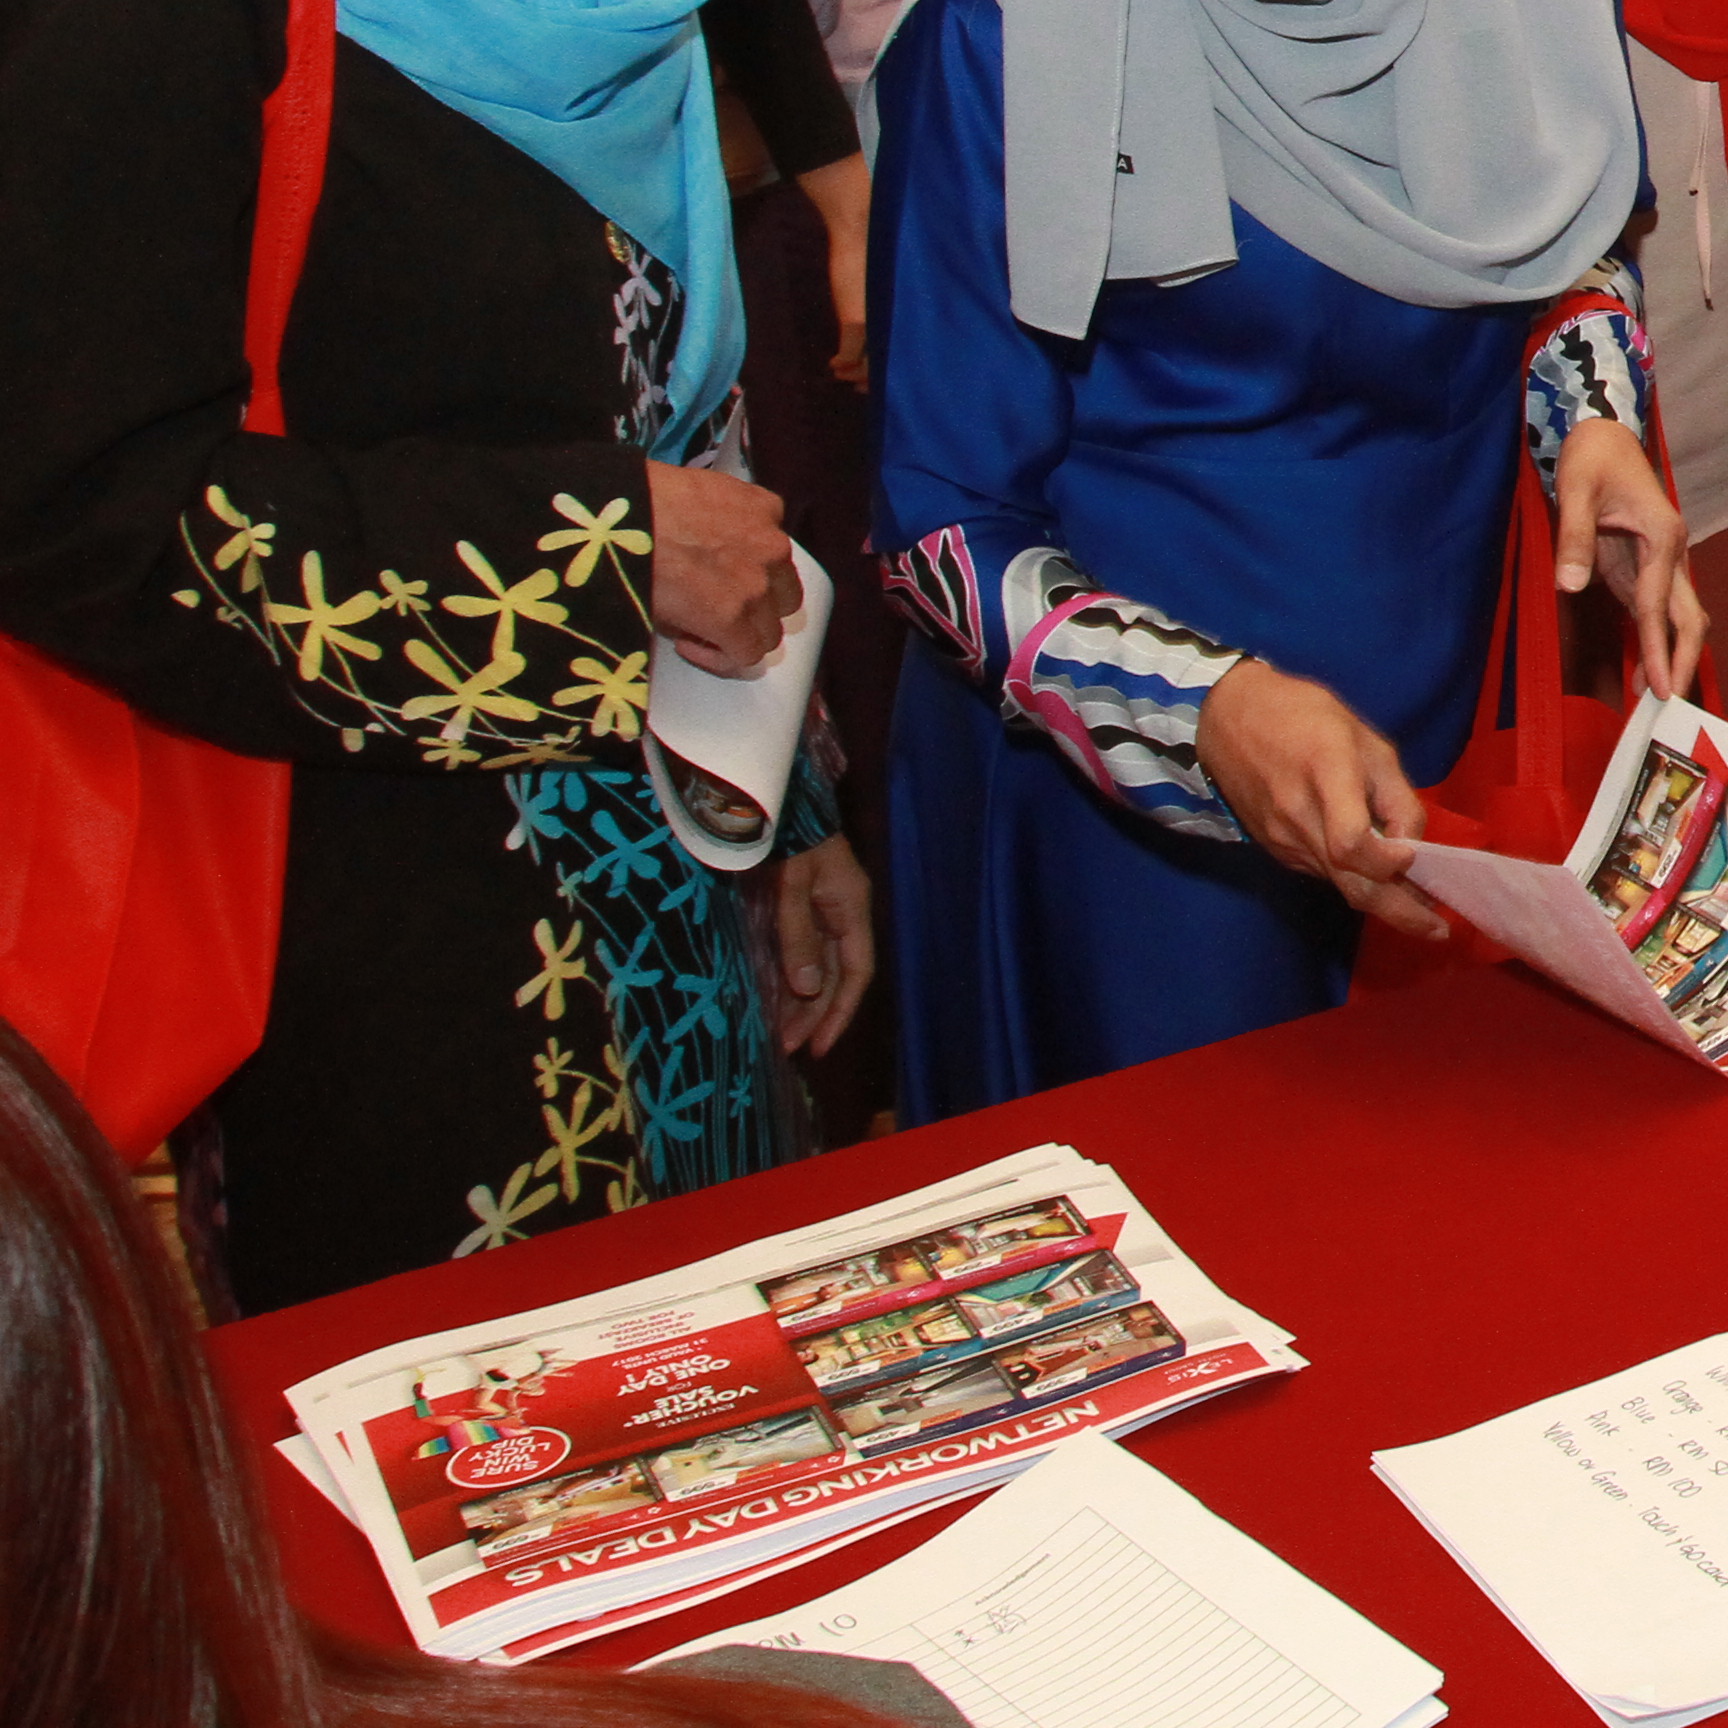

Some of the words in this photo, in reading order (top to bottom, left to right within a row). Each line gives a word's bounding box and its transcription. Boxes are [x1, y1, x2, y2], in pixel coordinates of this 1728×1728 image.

[645, 1354, 713, 1378] ONLY
[674, 1358, 731, 1382] ONE
[1166, 1357, 1234, 1385] LEXIS
[616, 1372, 668, 1397] DAY
[654, 1385, 714, 1407] SALE
[1662, 1379, 1704, 1415] Orange
[1621, 1396, 1656, 1424] Blue
[1678, 1439, 1709, 1460] RM
[468, 1442, 552, 1463] LUCKY
[491, 1435, 536, 1450] DIP
[782, 1400, 1100, 1508] NETWORKING
[1585, 1410, 1620, 1437] Pink
[1642, 1456, 1674, 1477] RM
[1668, 1477, 1703, 1498] 100
[470, 1460, 538, 1479] SURE
[483, 1452, 529, 1467] WIN
[1543, 1421, 1582, 1457] Yellow
[1578, 1458, 1596, 1471] or
[1591, 1470, 1628, 1501] Green
[1638, 1506, 1680, 1536] Touch
[683, 1497, 779, 1540] DAY
[505, 1525, 676, 1587] DEALS
